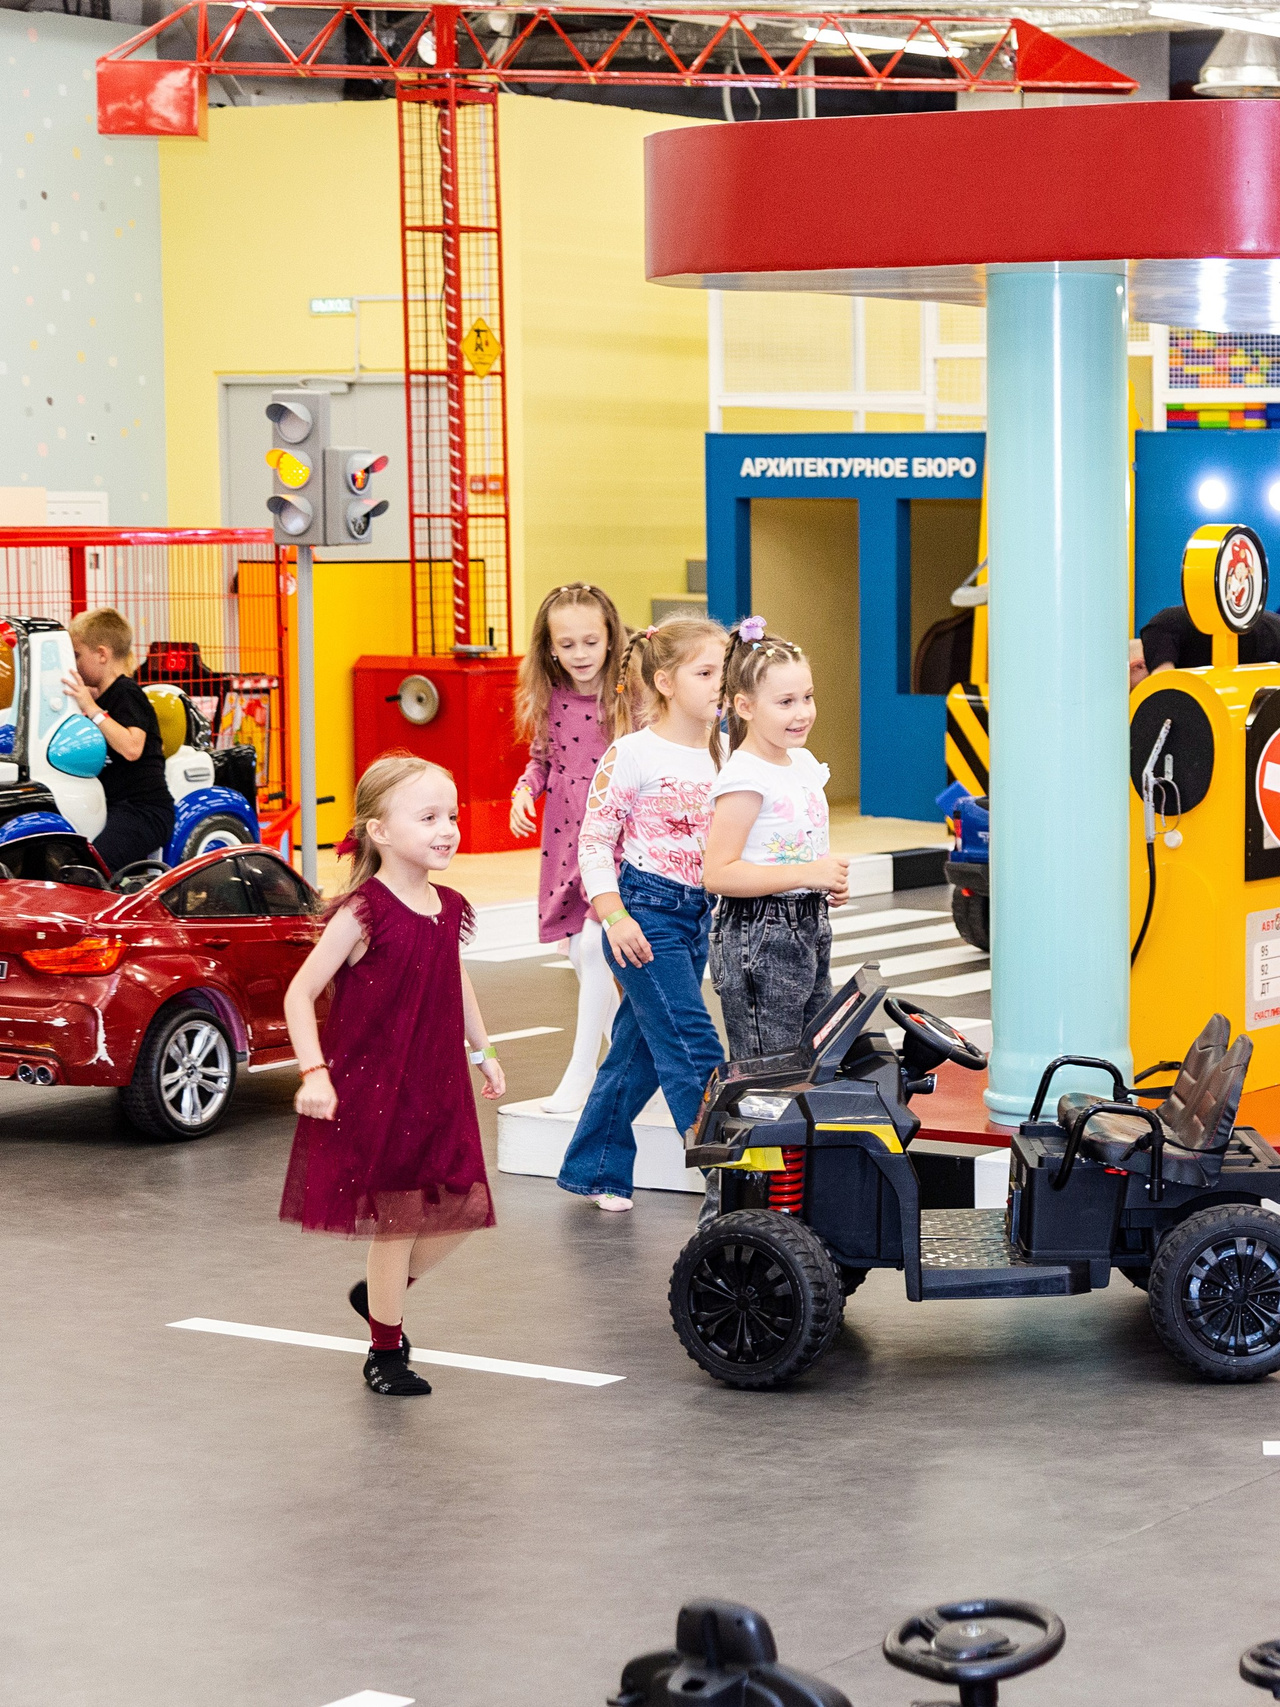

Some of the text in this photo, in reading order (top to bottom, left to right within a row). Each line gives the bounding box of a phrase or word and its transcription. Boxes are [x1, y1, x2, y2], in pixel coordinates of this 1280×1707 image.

[740, 457, 977, 479] АРХИТЕКТУРНОЕ БЮРО
[1260, 944, 1269, 957] 95
[1260, 963, 1269, 976] 92
[1260, 982, 1270, 996] ДТ
